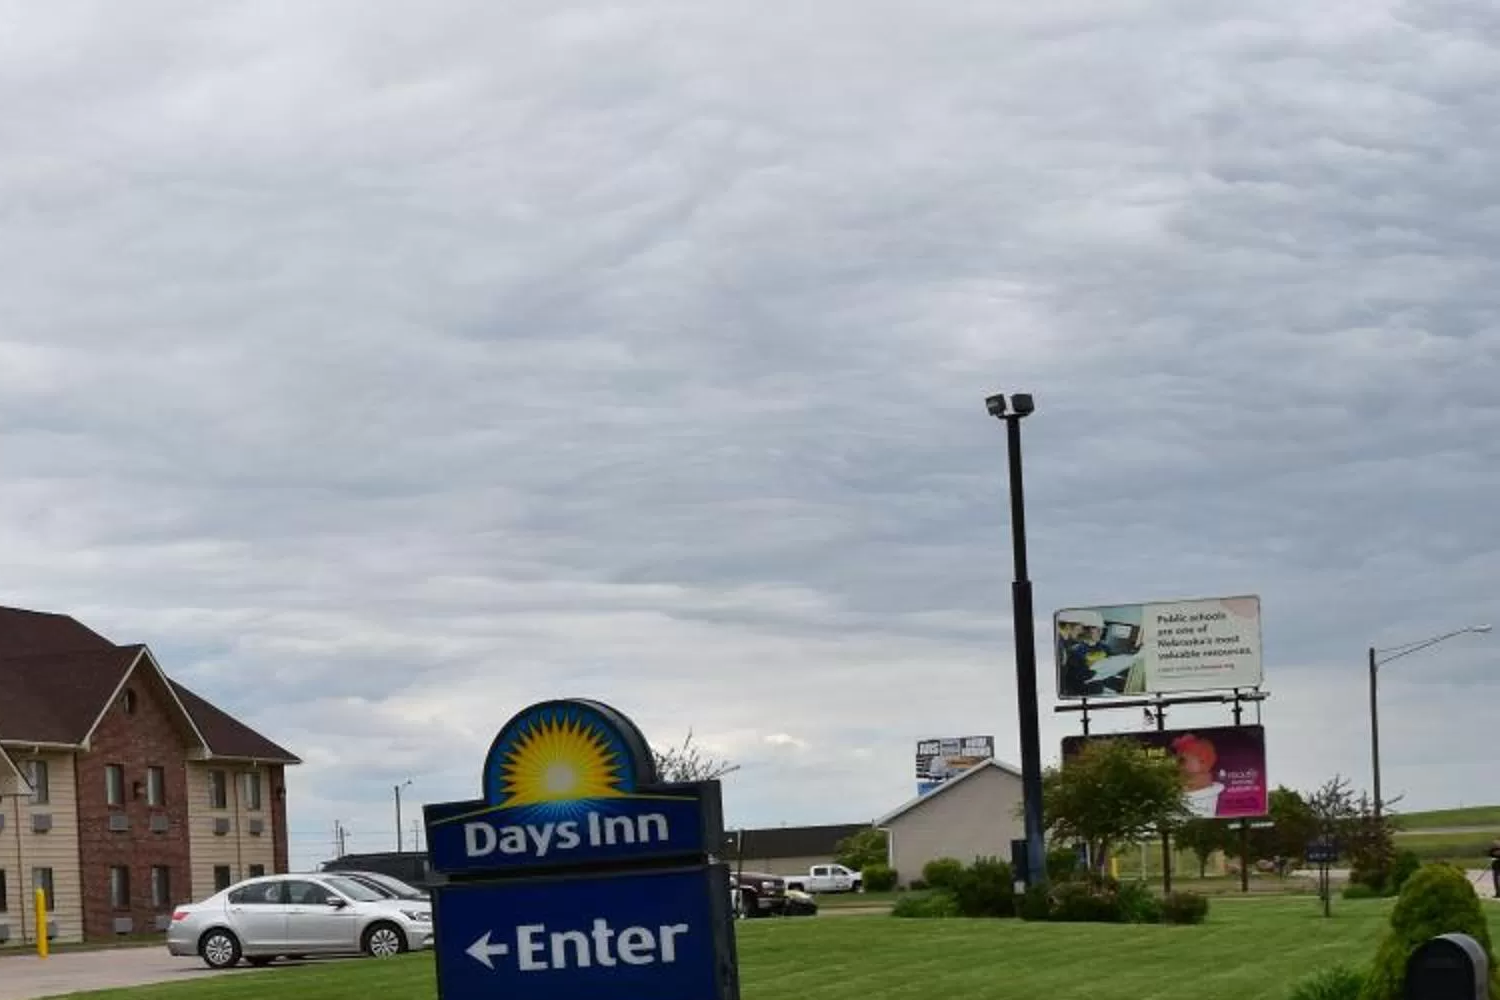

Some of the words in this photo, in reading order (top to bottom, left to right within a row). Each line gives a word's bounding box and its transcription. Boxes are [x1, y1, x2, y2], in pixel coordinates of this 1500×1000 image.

[1158, 614, 1187, 623] Public
[1190, 612, 1226, 621] schools
[465, 821, 581, 857] Days
[588, 811, 669, 846] Inn
[516, 918, 689, 971] Enter
